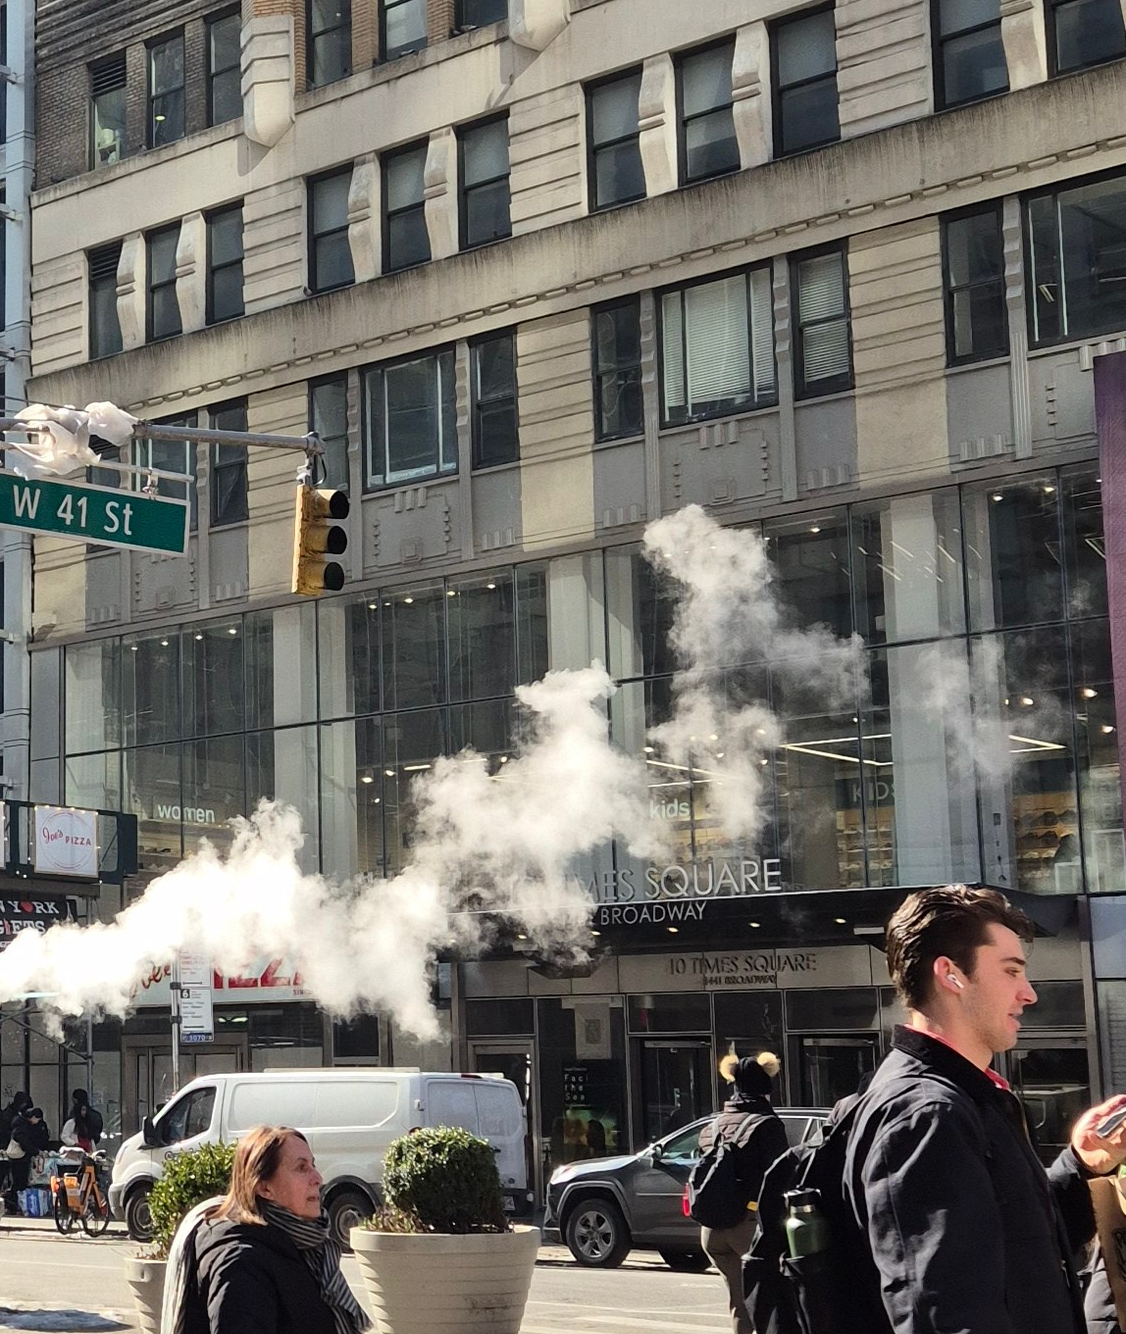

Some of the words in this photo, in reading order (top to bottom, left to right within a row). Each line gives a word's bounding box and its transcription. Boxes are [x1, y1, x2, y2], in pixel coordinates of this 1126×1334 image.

[12, 484, 41, 519] W
[56, 494, 88, 528] 41
[103, 501, 134, 536] St
[157, 803, 215, 823] women
[648, 798, 691, 820] kids
[42, 826, 64, 843] Joe's
[65, 835, 92, 846] PIZZA
[644, 858, 783, 898] SQUARE
[600, 901, 707, 926] BROADWAY
[669, 957, 686, 975] 10
[690, 956, 740, 975] TIMES
[743, 953, 817, 973] SQUARE
